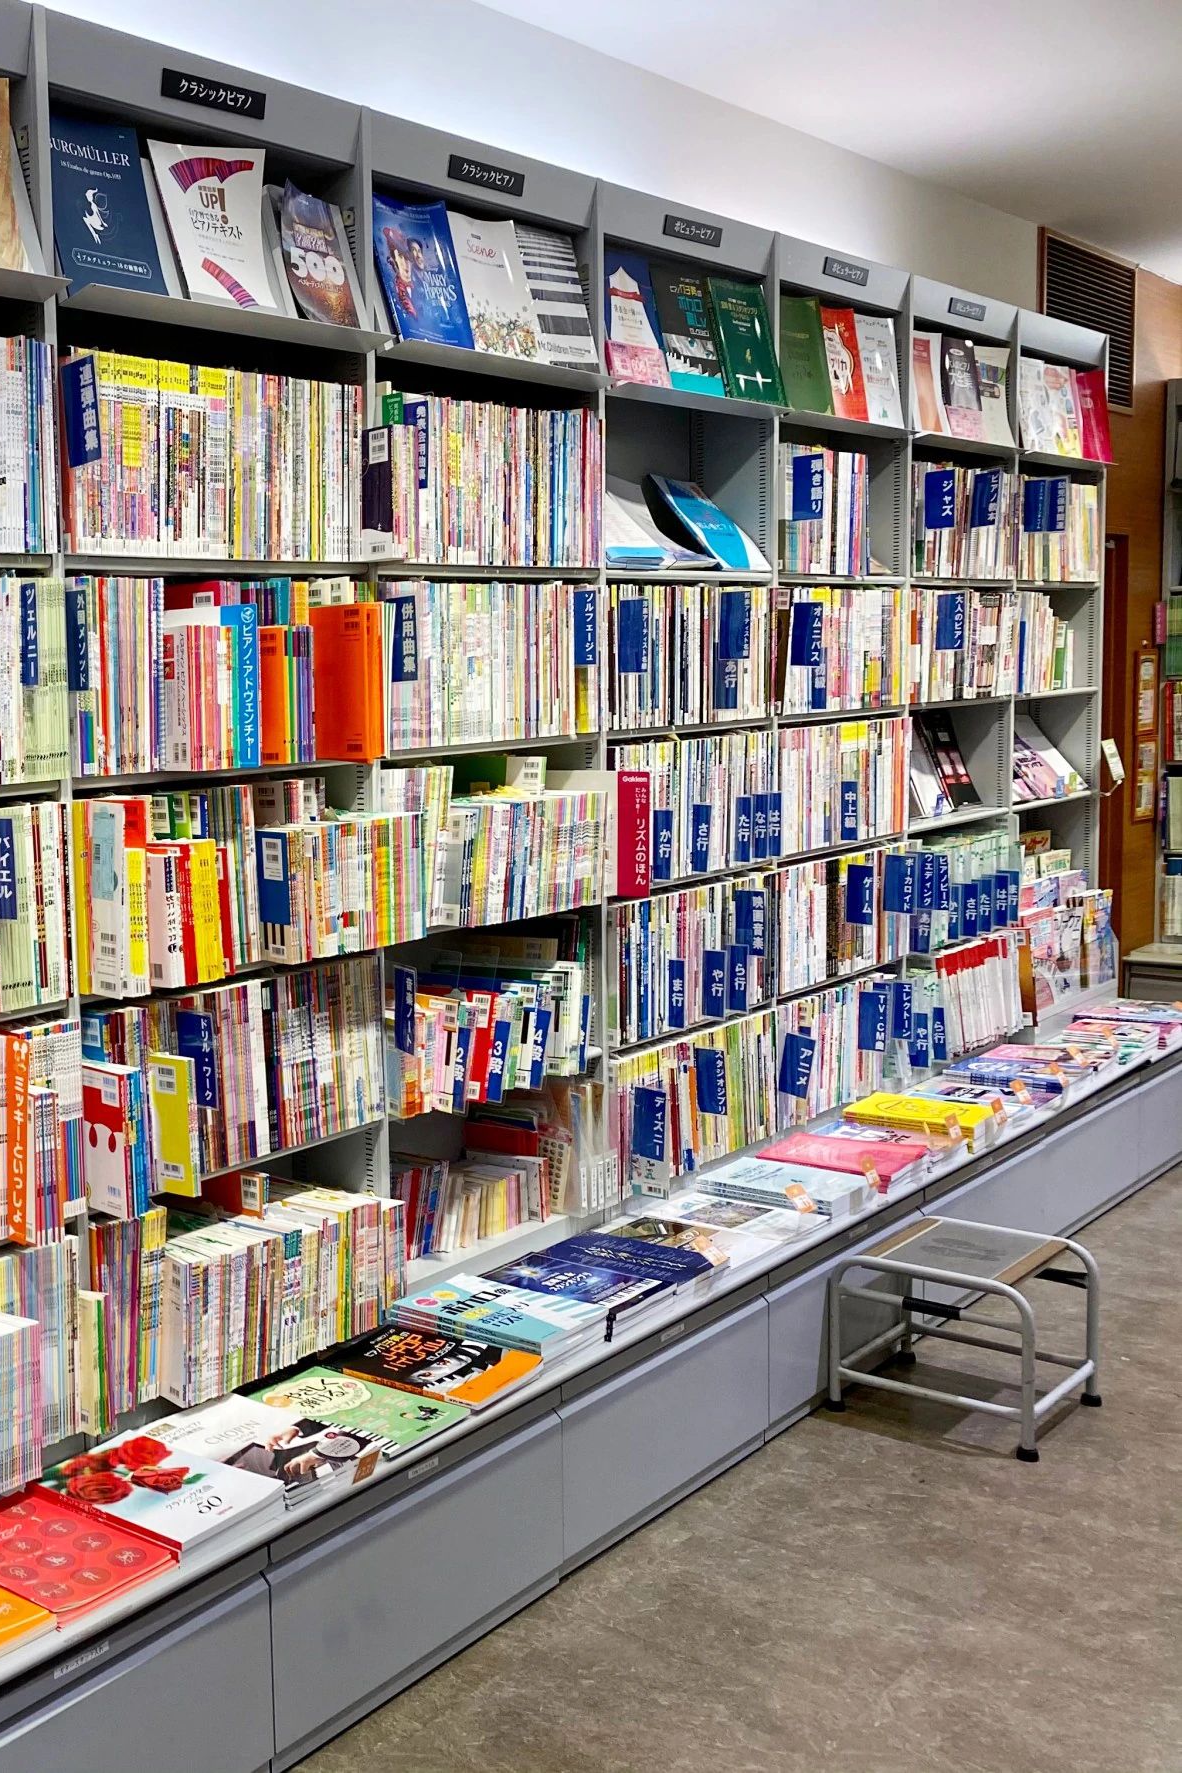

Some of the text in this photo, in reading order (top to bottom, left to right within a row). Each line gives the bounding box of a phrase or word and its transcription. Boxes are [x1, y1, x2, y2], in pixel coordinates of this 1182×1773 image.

[179, 78, 253, 110] クラシックピアノ
[461, 162, 516, 188] クラシックピアノ
[191, 218, 244, 241] ピアノテキスト
[674, 220, 716, 241] ポピュラーピアノ
[291, 246, 345, 287] 500
[465, 239, 497, 259] Scene
[79, 362, 99, 452] 連弾曲集
[810, 459, 823, 513] 弾き語り
[941, 480, 954, 517] ジャズ
[24, 588, 37, 680] ツェルニー
[401, 602, 416, 673] 併用曲集
[584, 593, 595, 661] ソルフェージュ
[811, 604, 822, 663] オムニバス
[953, 594, 964, 649] 大人のピアノ
[76, 594, 86, 688] 外国メソッド
[241, 624, 256, 760] ピアノ・アドヴェンチャー
[622, 775, 648, 783] Gakken
[738, 814, 751, 842] た行
[754, 811, 767, 840] な行
[769, 809, 781, 837] は行
[844, 791, 857, 829] 中上級
[635, 818, 647, 886] リズムのほん
[659, 829, 672, 859] か行
[696, 823, 709, 851] さ行
[862, 876, 873, 914] ゲーム
[903, 857, 915, 911] ボーカロイド
[922, 854, 933, 907] ウエディング
[938, 855, 949, 909] ピアノピース
[965, 897, 978, 921] さ行
[979, 892, 992, 916] た行
[995, 887, 1008, 912] は行
[752, 894, 764, 950] 映画音楽
[918, 912, 931, 937] あ行
[672, 978, 684, 1007] ま行
[711, 969, 725, 997] や行
[734, 963, 747, 991] ら行
[405, 976, 414, 1046] 音楽ノート
[902, 984, 913, 1038] エレクトーン
[531, 1028, 544, 1063] 4段
[933, 1021, 946, 1045] ら行
[200, 1017, 213, 1101] ドリル・ワーク
[454, 1048, 464, 1080] 2段
[489, 1040, 503, 1075] 3段
[795, 1047, 815, 1087] アニメ
[714, 1050, 728, 1116] スタジオジブリ
[653, 1095, 666, 1157] ディズニー
[12, 1074, 25, 1226] ミッキーといっしょ
[284, 1378, 342, 1402] やさしく
[204, 1418, 262, 1445] CHOPIN
[197, 1495, 224, 1515] 50
